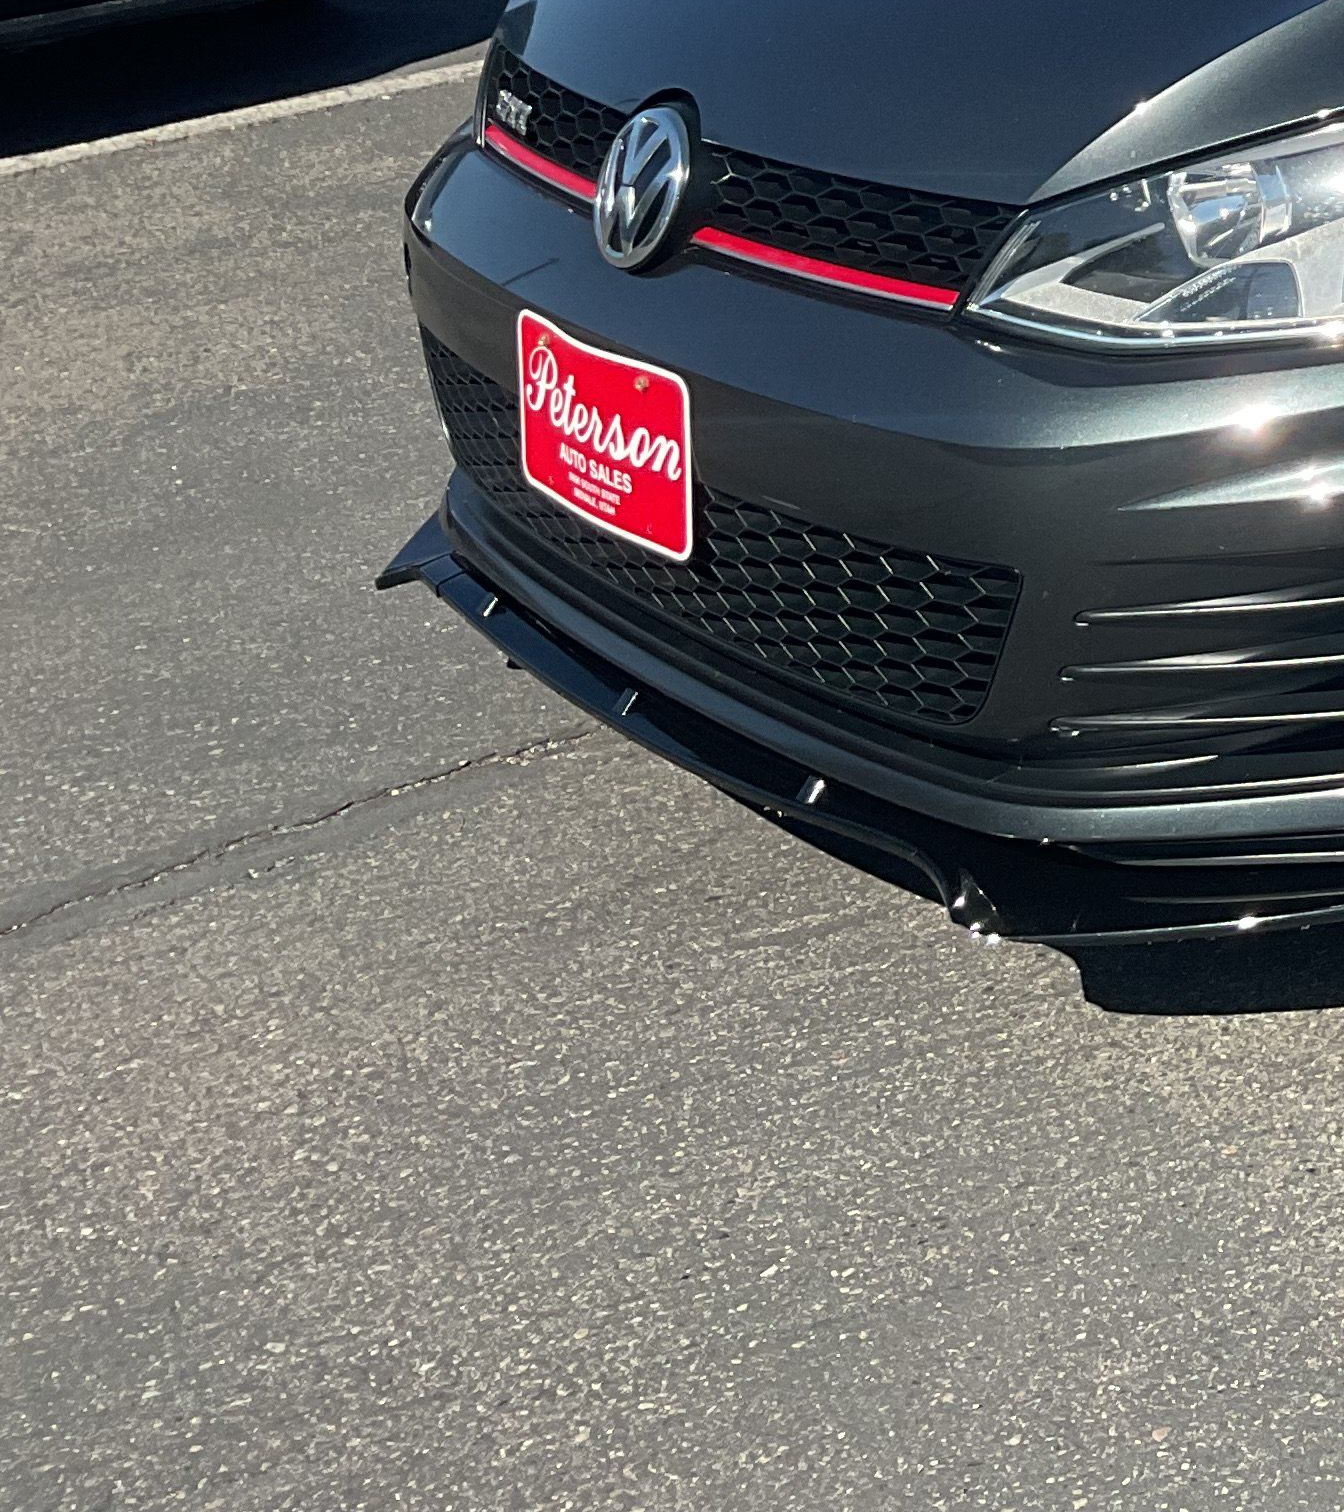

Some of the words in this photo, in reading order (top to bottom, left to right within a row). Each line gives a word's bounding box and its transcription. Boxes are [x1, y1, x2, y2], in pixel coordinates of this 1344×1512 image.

[526, 345, 682, 481] Peterson
[560, 442, 587, 474] AUTO
[589, 458, 633, 495] SALES
